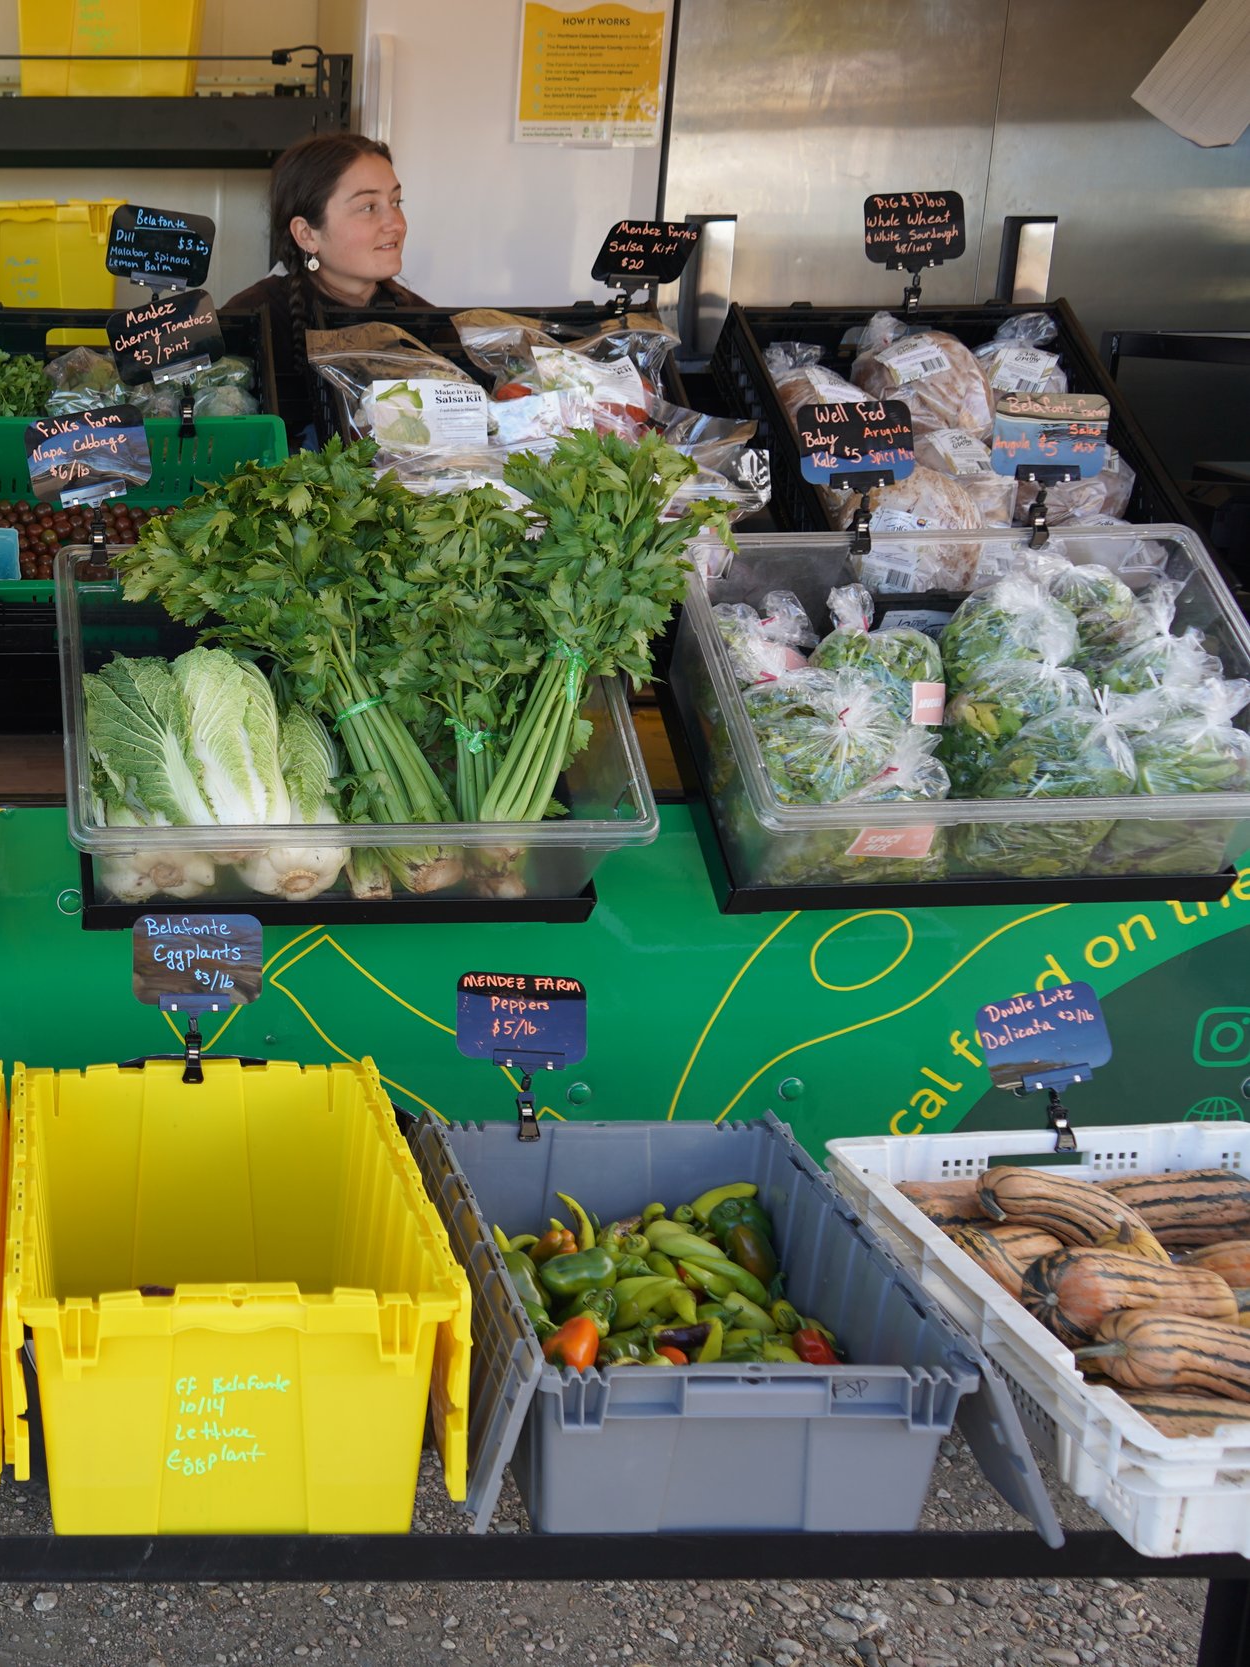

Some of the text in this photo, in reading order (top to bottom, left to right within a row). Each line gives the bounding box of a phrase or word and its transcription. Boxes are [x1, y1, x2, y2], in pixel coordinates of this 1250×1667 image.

[562, 17, 631, 26] HOW IT WORKS
[900, 194, 911, 208] &
[911, 192, 947, 209] Plow
[136, 208, 188, 229] Belafonte
[616, 221, 663, 237] Mendez
[866, 210, 951, 228] Whole Wheat
[116, 229, 136, 244] Dill
[178, 236, 194, 251] $3
[873, 230, 901, 243] White
[909, 224, 959, 246] Sourdough
[110, 246, 191, 266] Malabar Spinach
[609, 239, 679, 256] Salsa Kit!
[108, 258, 173, 272] Lemon Balm
[621, 256, 645, 271] $20
[125, 302, 177, 328] Mendez
[161, 311, 213, 335] Tomatoes
[434, 389, 456, 397] Make
[435, 394, 482, 404] Salsa Kit
[815, 402, 850, 424] Well
[1005, 395, 1075, 416] Belafonte
[801, 427, 840, 455] Baby
[863, 423, 911, 445] Arugula
[1037, 432, 1060, 458] $5
[32, 432, 127, 464] Napa Cabbage
[812, 445, 863, 468] Kale $5
[867, 446, 914, 466] Spicy Mix
[49, 458, 91, 482] $6/lb
[144, 916, 232, 938] Belafonte
[1084, 913, 1157, 969] on
[153, 943, 241, 972] Eggplants
[193, 968, 235, 991] $3/lb
[462, 974, 582, 993] MENDEZ FARM
[490, 995, 551, 1015] Peppers
[983, 988, 1076, 1023] Double Lutz
[982, 1018, 1057, 1050] Delicata
[179, 1396, 226, 1418] 10/14
[175, 1420, 258, 1441] Lettuce
[166, 1443, 268, 1476] Eggplant
